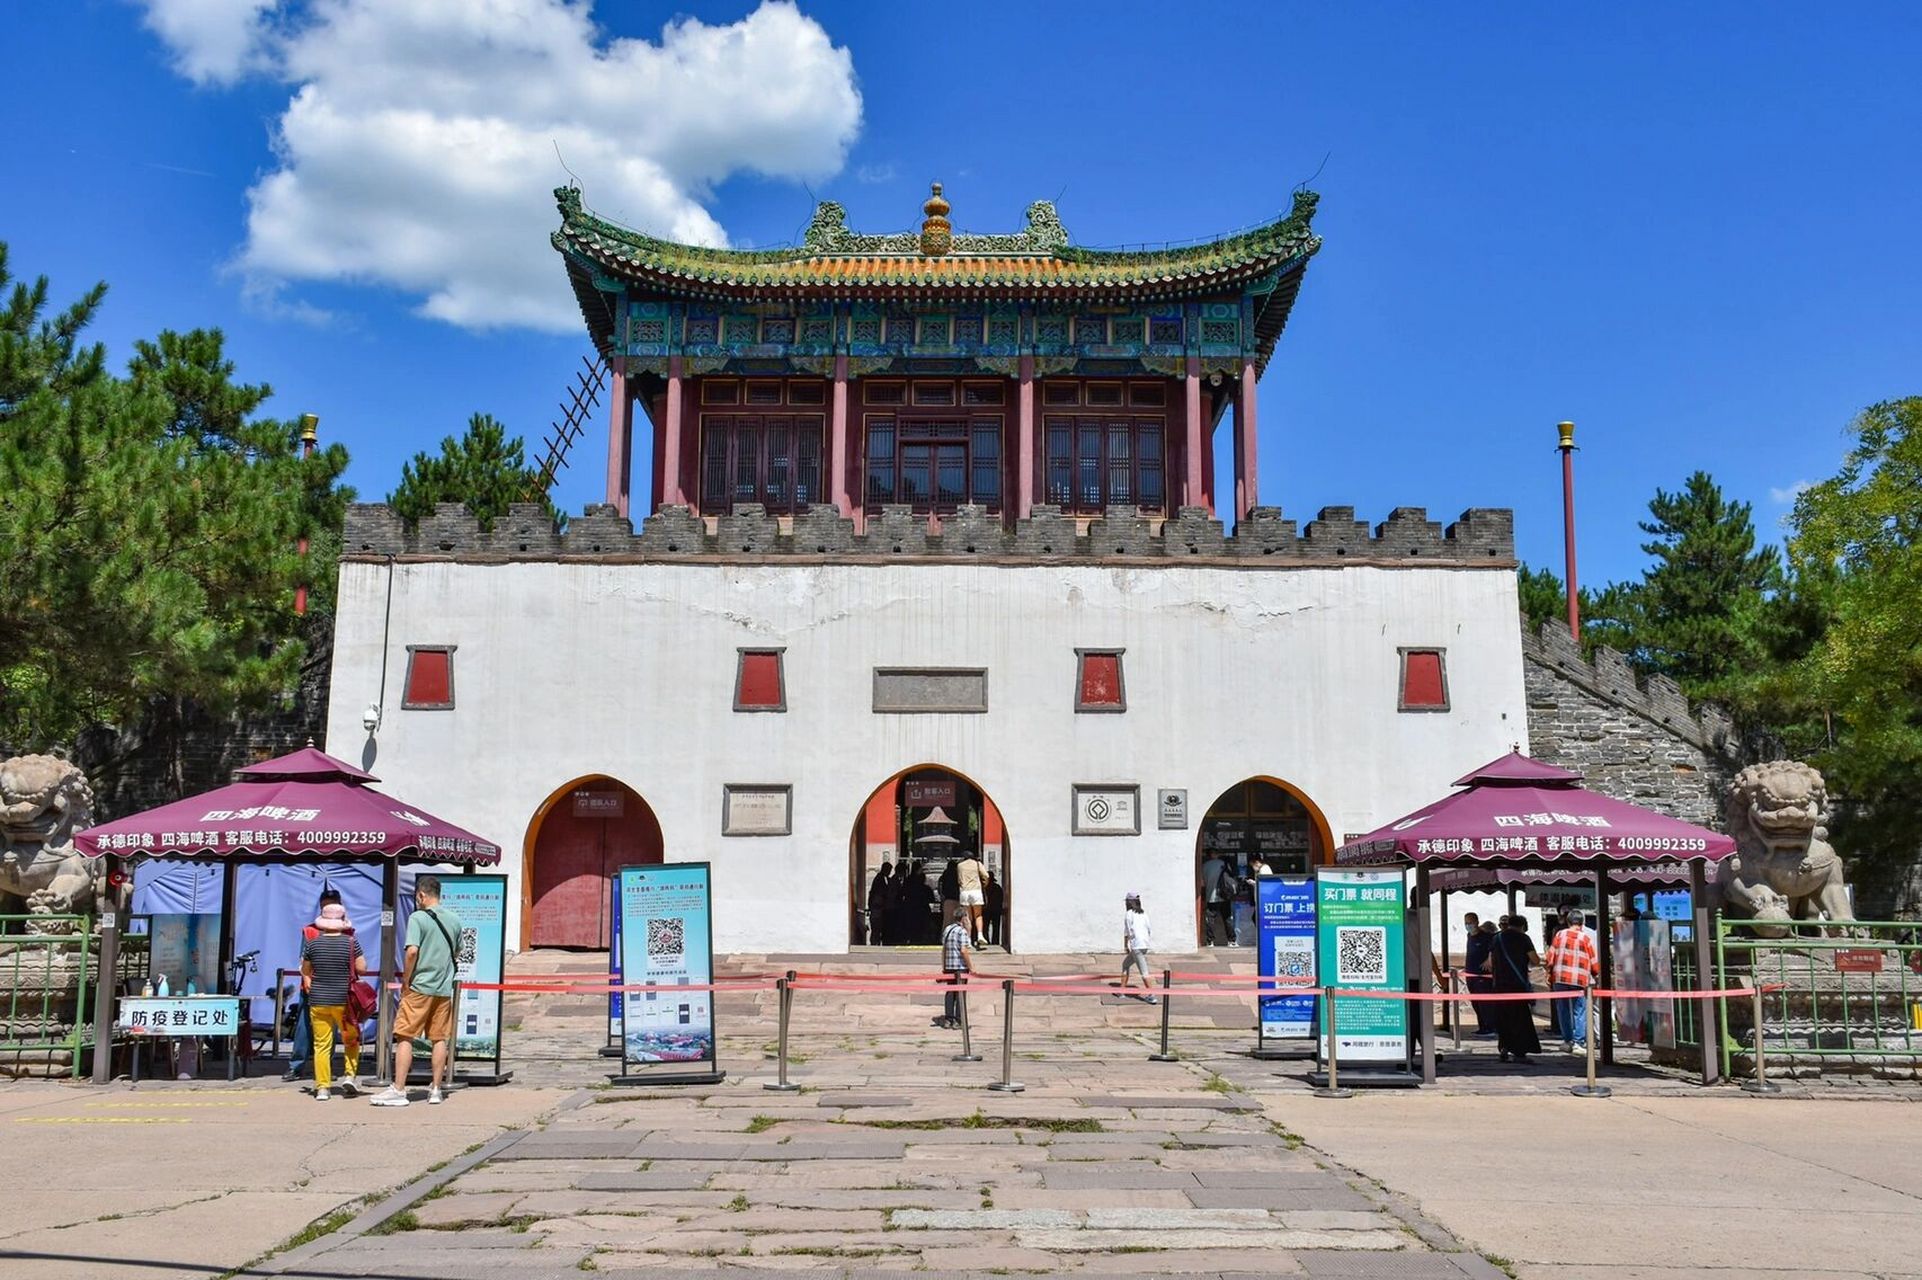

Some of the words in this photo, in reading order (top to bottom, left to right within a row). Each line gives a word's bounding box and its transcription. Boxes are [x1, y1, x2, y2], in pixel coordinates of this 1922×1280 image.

[200, 806, 320, 822] 四海啤酒
[1494, 812, 1612, 828] 四海啤酒
[97, 832, 156, 849] 承德印象
[161, 831, 219, 847] 四海啤酒
[1416, 838, 1475, 854] 承德印象
[1480, 836, 1539, 852] 四海啤酒
[1324, 887, 1358, 902] 买门票
[1360, 887, 1397, 902] 就同程
[1264, 902, 1294, 914] 订门票
[131, 1007, 230, 1027] 防疫登记处
